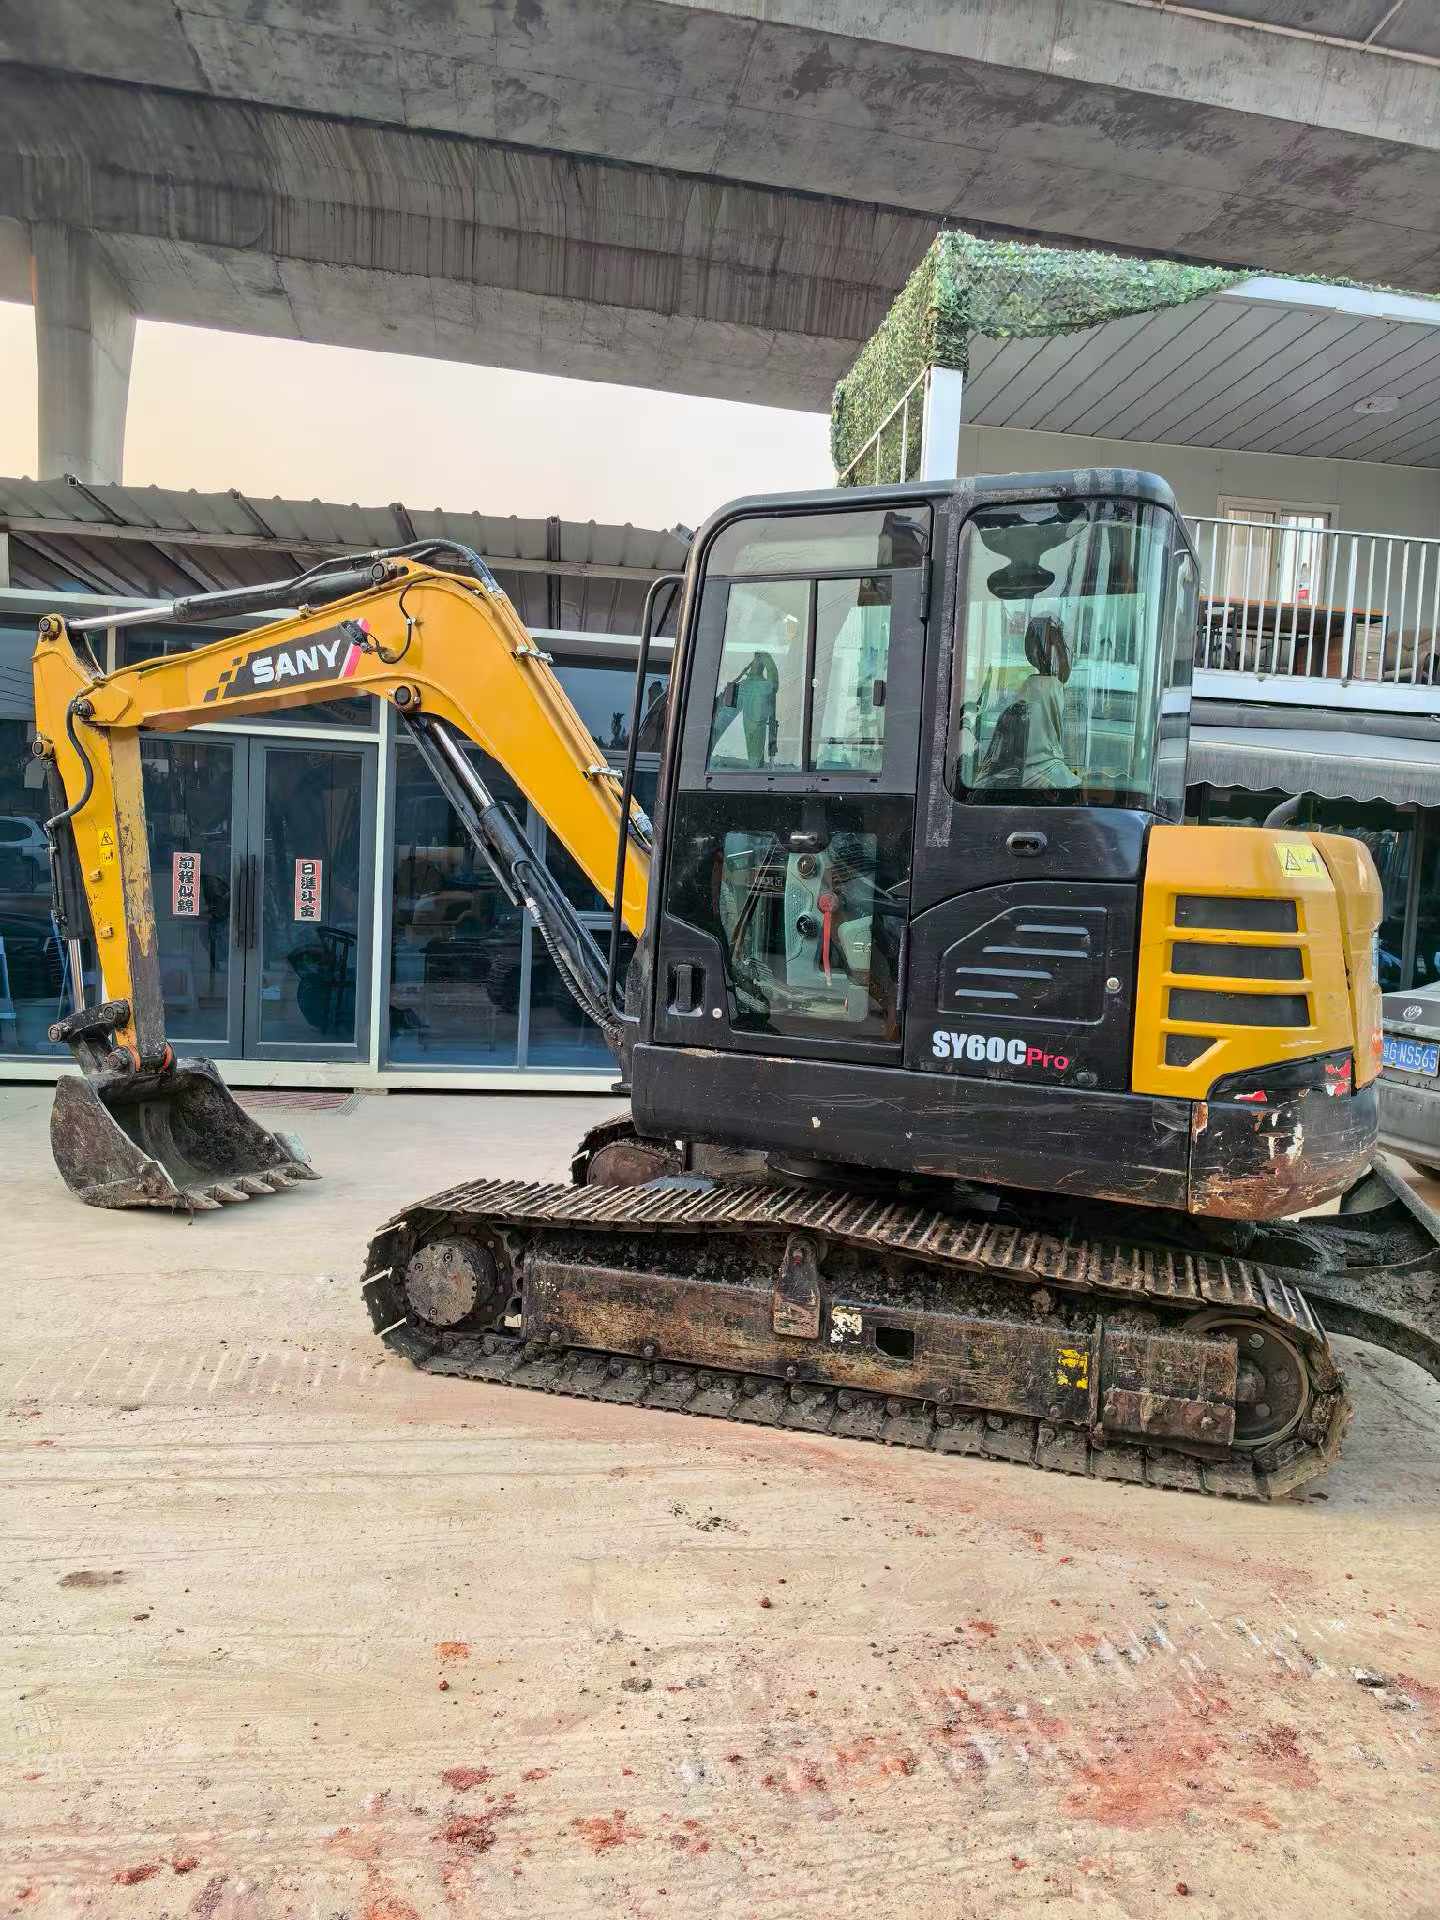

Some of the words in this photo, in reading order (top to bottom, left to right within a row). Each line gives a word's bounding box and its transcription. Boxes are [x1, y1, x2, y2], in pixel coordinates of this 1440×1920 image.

[251, 640, 340, 684] SANY
[932, 1030, 1027, 1065] SY60C
[1026, 1046, 1070, 1070] Pro
